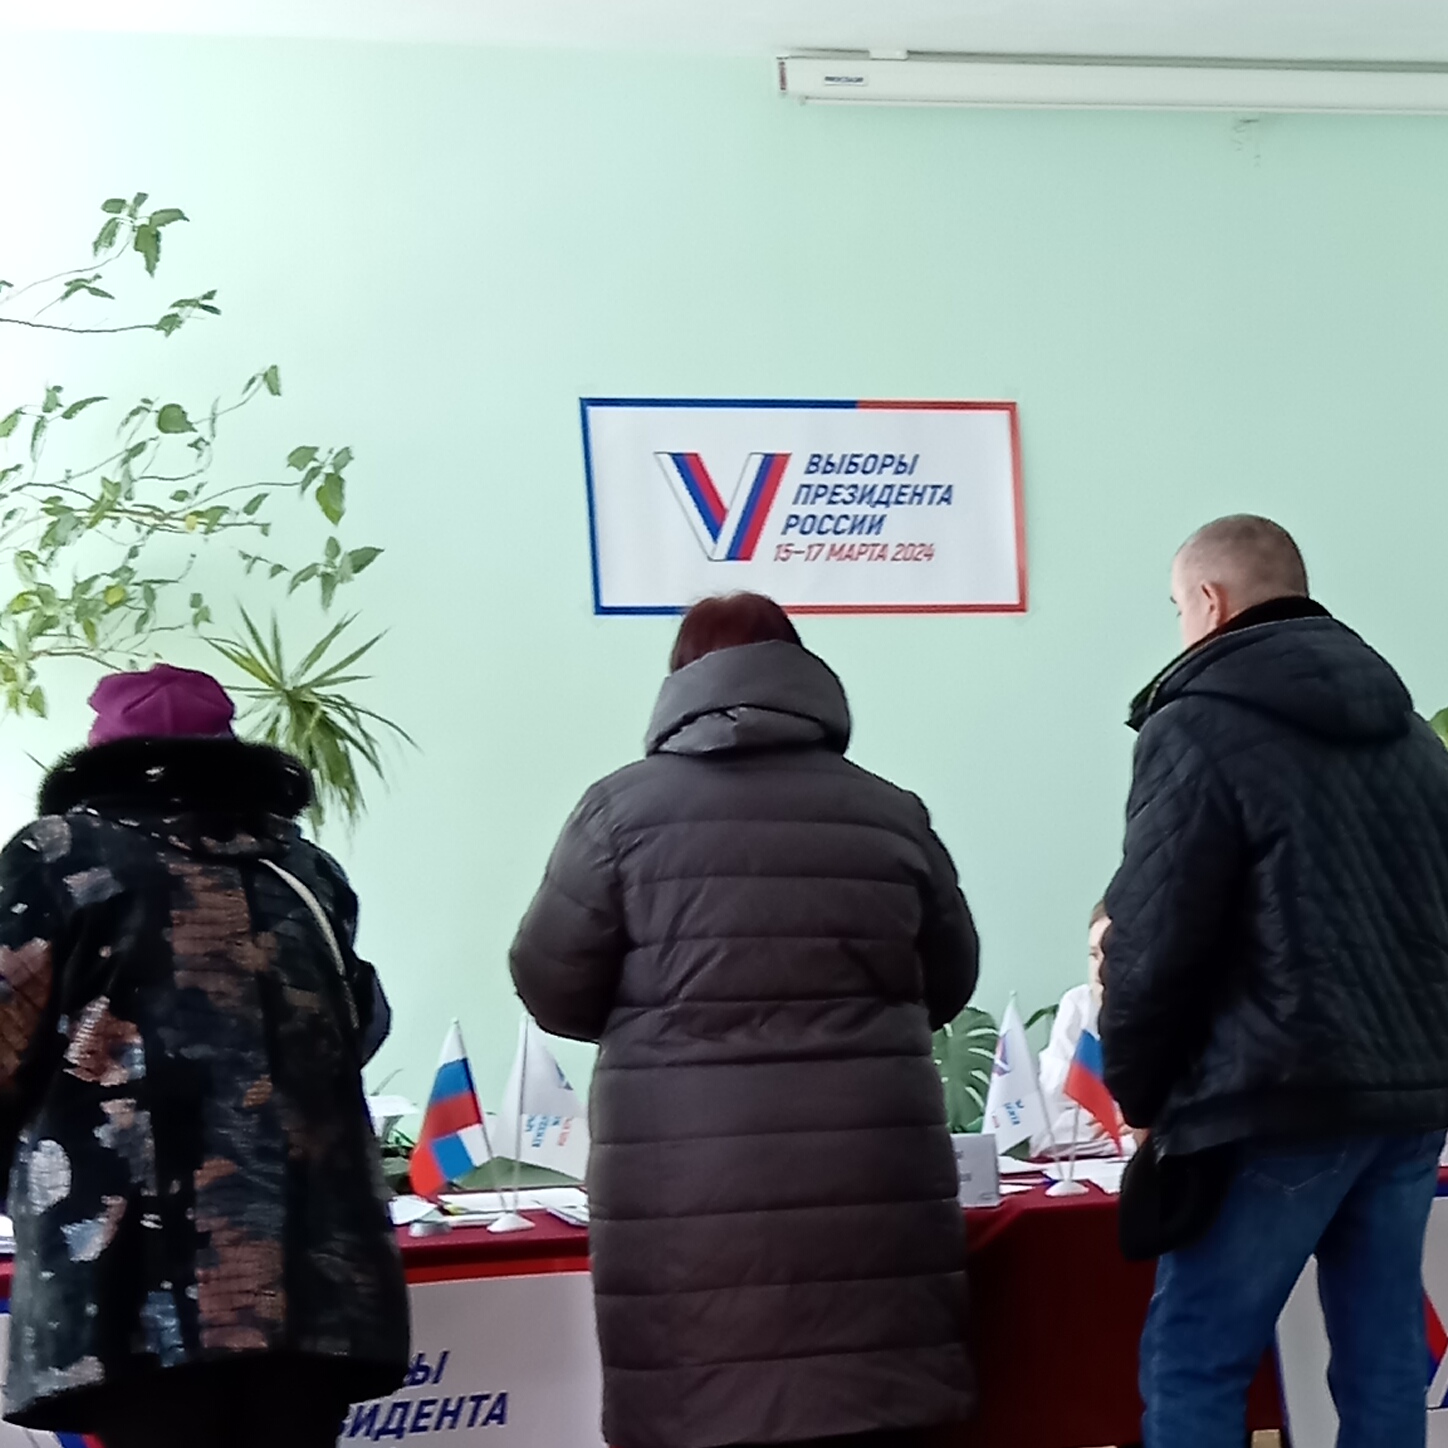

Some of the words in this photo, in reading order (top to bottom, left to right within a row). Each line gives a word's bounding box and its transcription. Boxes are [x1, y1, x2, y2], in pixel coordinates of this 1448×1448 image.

[804, 452, 920, 475] ВЫБОРЫ
[791, 483, 954, 508] ПРЕЗИДЕНТА
[780, 513, 888, 535] РОССИИ
[825, 542, 889, 562] МАРТА
[890, 542, 936, 562] 2024
[340, 1392, 508, 1441] ИДЕНТА
